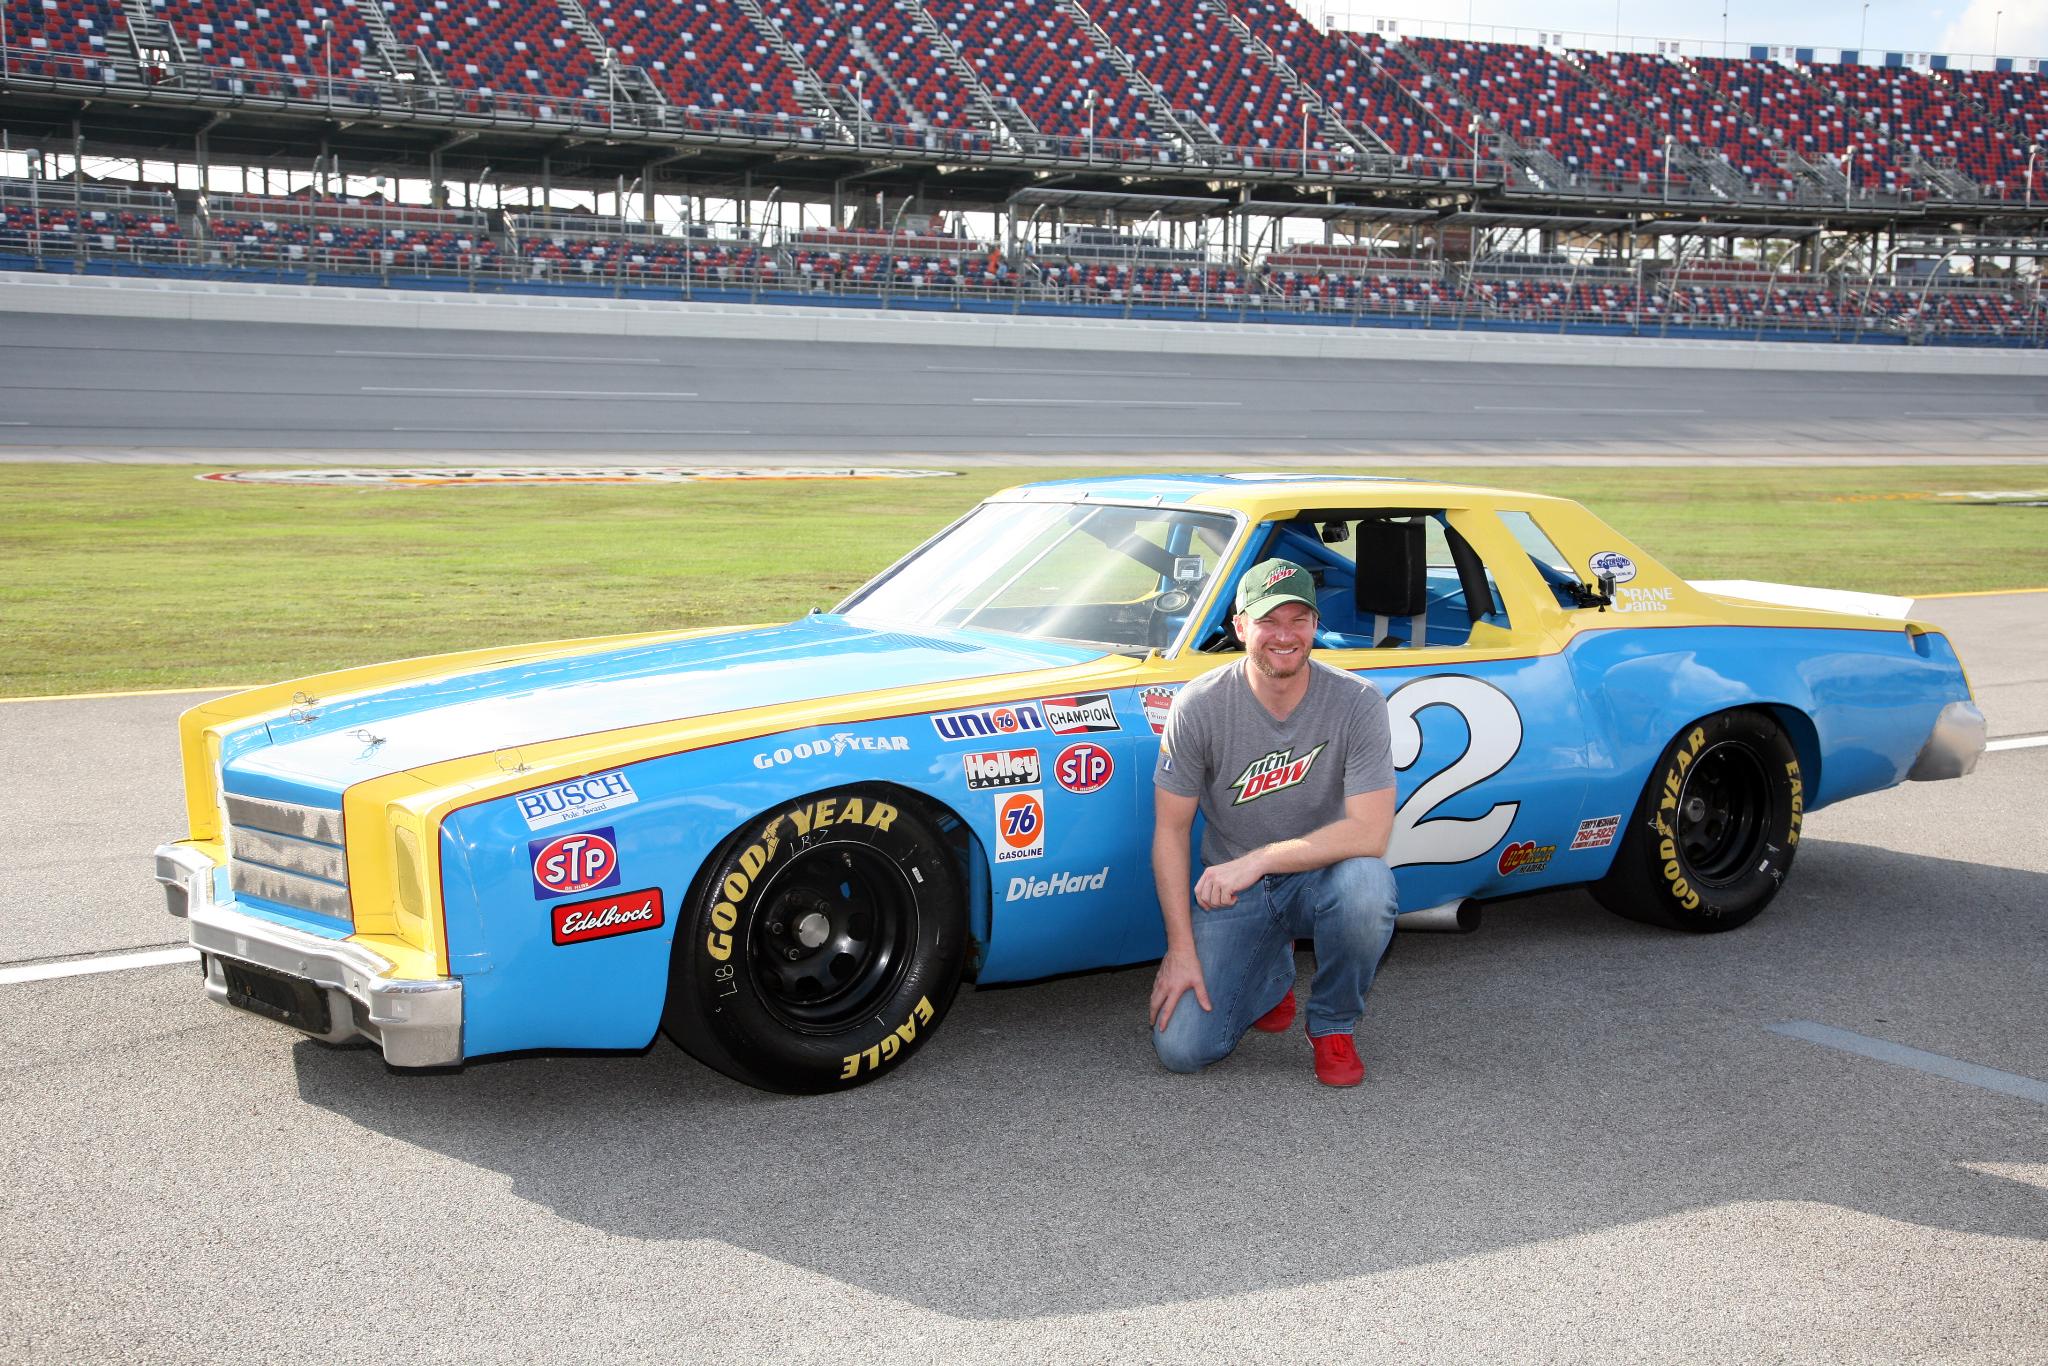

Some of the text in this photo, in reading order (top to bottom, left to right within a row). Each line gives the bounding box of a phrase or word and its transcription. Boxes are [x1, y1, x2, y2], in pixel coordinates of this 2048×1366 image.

[996, 713, 1015, 729] 76
[1049, 707, 1111, 725] CHAMPION
[753, 732, 911, 769] GOODYEAR
[965, 751, 1039, 782] Holley
[1062, 747, 1106, 784] STP
[969, 776, 1021, 788] CARBS
[1385, 672, 1524, 870] 2
[517, 773, 632, 820] BUSCH
[561, 803, 607, 821] Pole Award
[1784, 759, 1804, 846] EAGLE
[1005, 802, 1037, 837] 76
[1656, 726, 1707, 910] GOODYEAR
[545, 839, 606, 884] STP
[998, 848, 1043, 860] GASOLINE
[707, 798, 898, 961] GOODYEAR
[1006, 866, 1110, 902] DieHard
[561, 900, 654, 935] Edelbrock
[840, 995, 936, 1080] EAGLE
